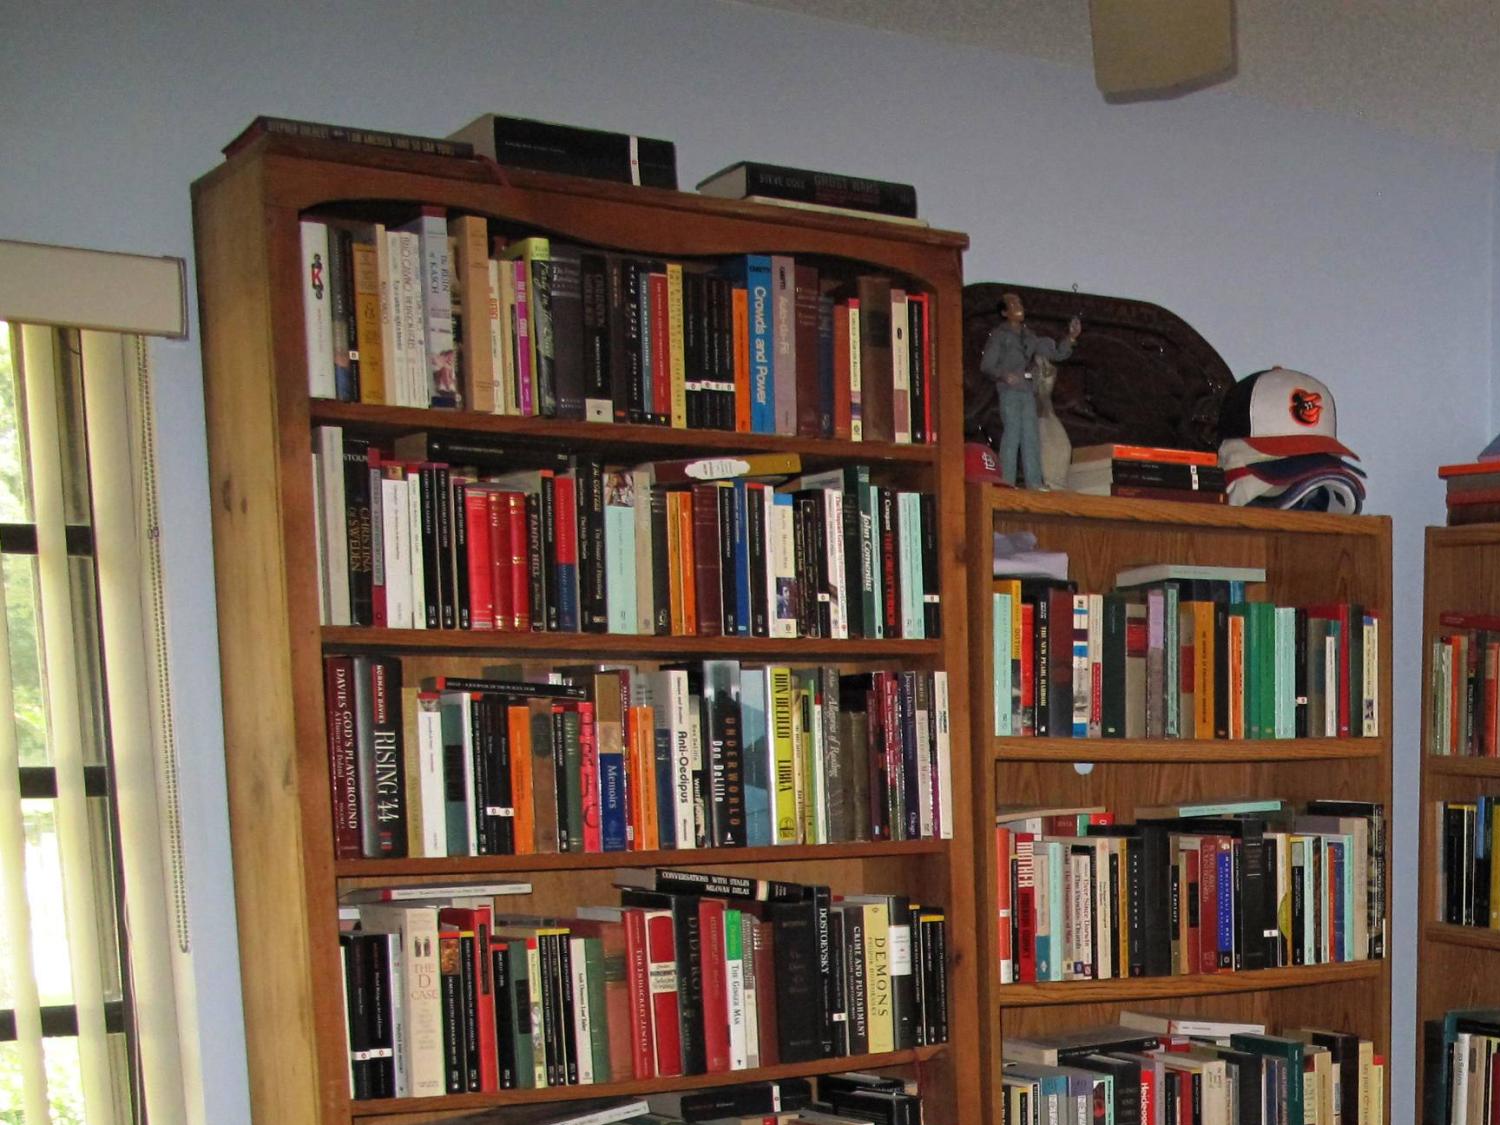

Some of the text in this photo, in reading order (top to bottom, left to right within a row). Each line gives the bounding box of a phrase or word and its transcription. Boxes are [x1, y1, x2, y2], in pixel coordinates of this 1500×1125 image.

[753, 286, 767, 334] Crowds
[755, 339, 767, 361] and
[756, 366, 768, 405] Power
[350, 520, 361, 571] SWEDEN
[359, 507, 370, 572] CHRISTINA
[531, 514, 541, 577] FANNY HILL
[860, 512, 874, 592] John Comenius
[336, 668, 347, 708] DAVIES
[774, 674, 790, 739] DON DELILLO
[343, 711, 358, 829] GOD'S PLAYGROUND
[373, 730, 401, 822] RISING '44
[607, 765, 618, 809] Memoirs
[678, 731, 690, 804] Anti-Oedipus
[713, 741, 724, 802] Don DeLillo
[725, 717, 738, 826] UNDERWORLD
[778, 760, 792, 792] LIBRA
[1017, 842, 1034, 888] MOTHER
[688, 916, 700, 1001] DIDEROT
[819, 908, 830, 974] DOSTOEVSKY
[853, 926, 865, 1037] CRIME AND PUNISHMENT
[875, 938, 888, 1016] DEMONS
